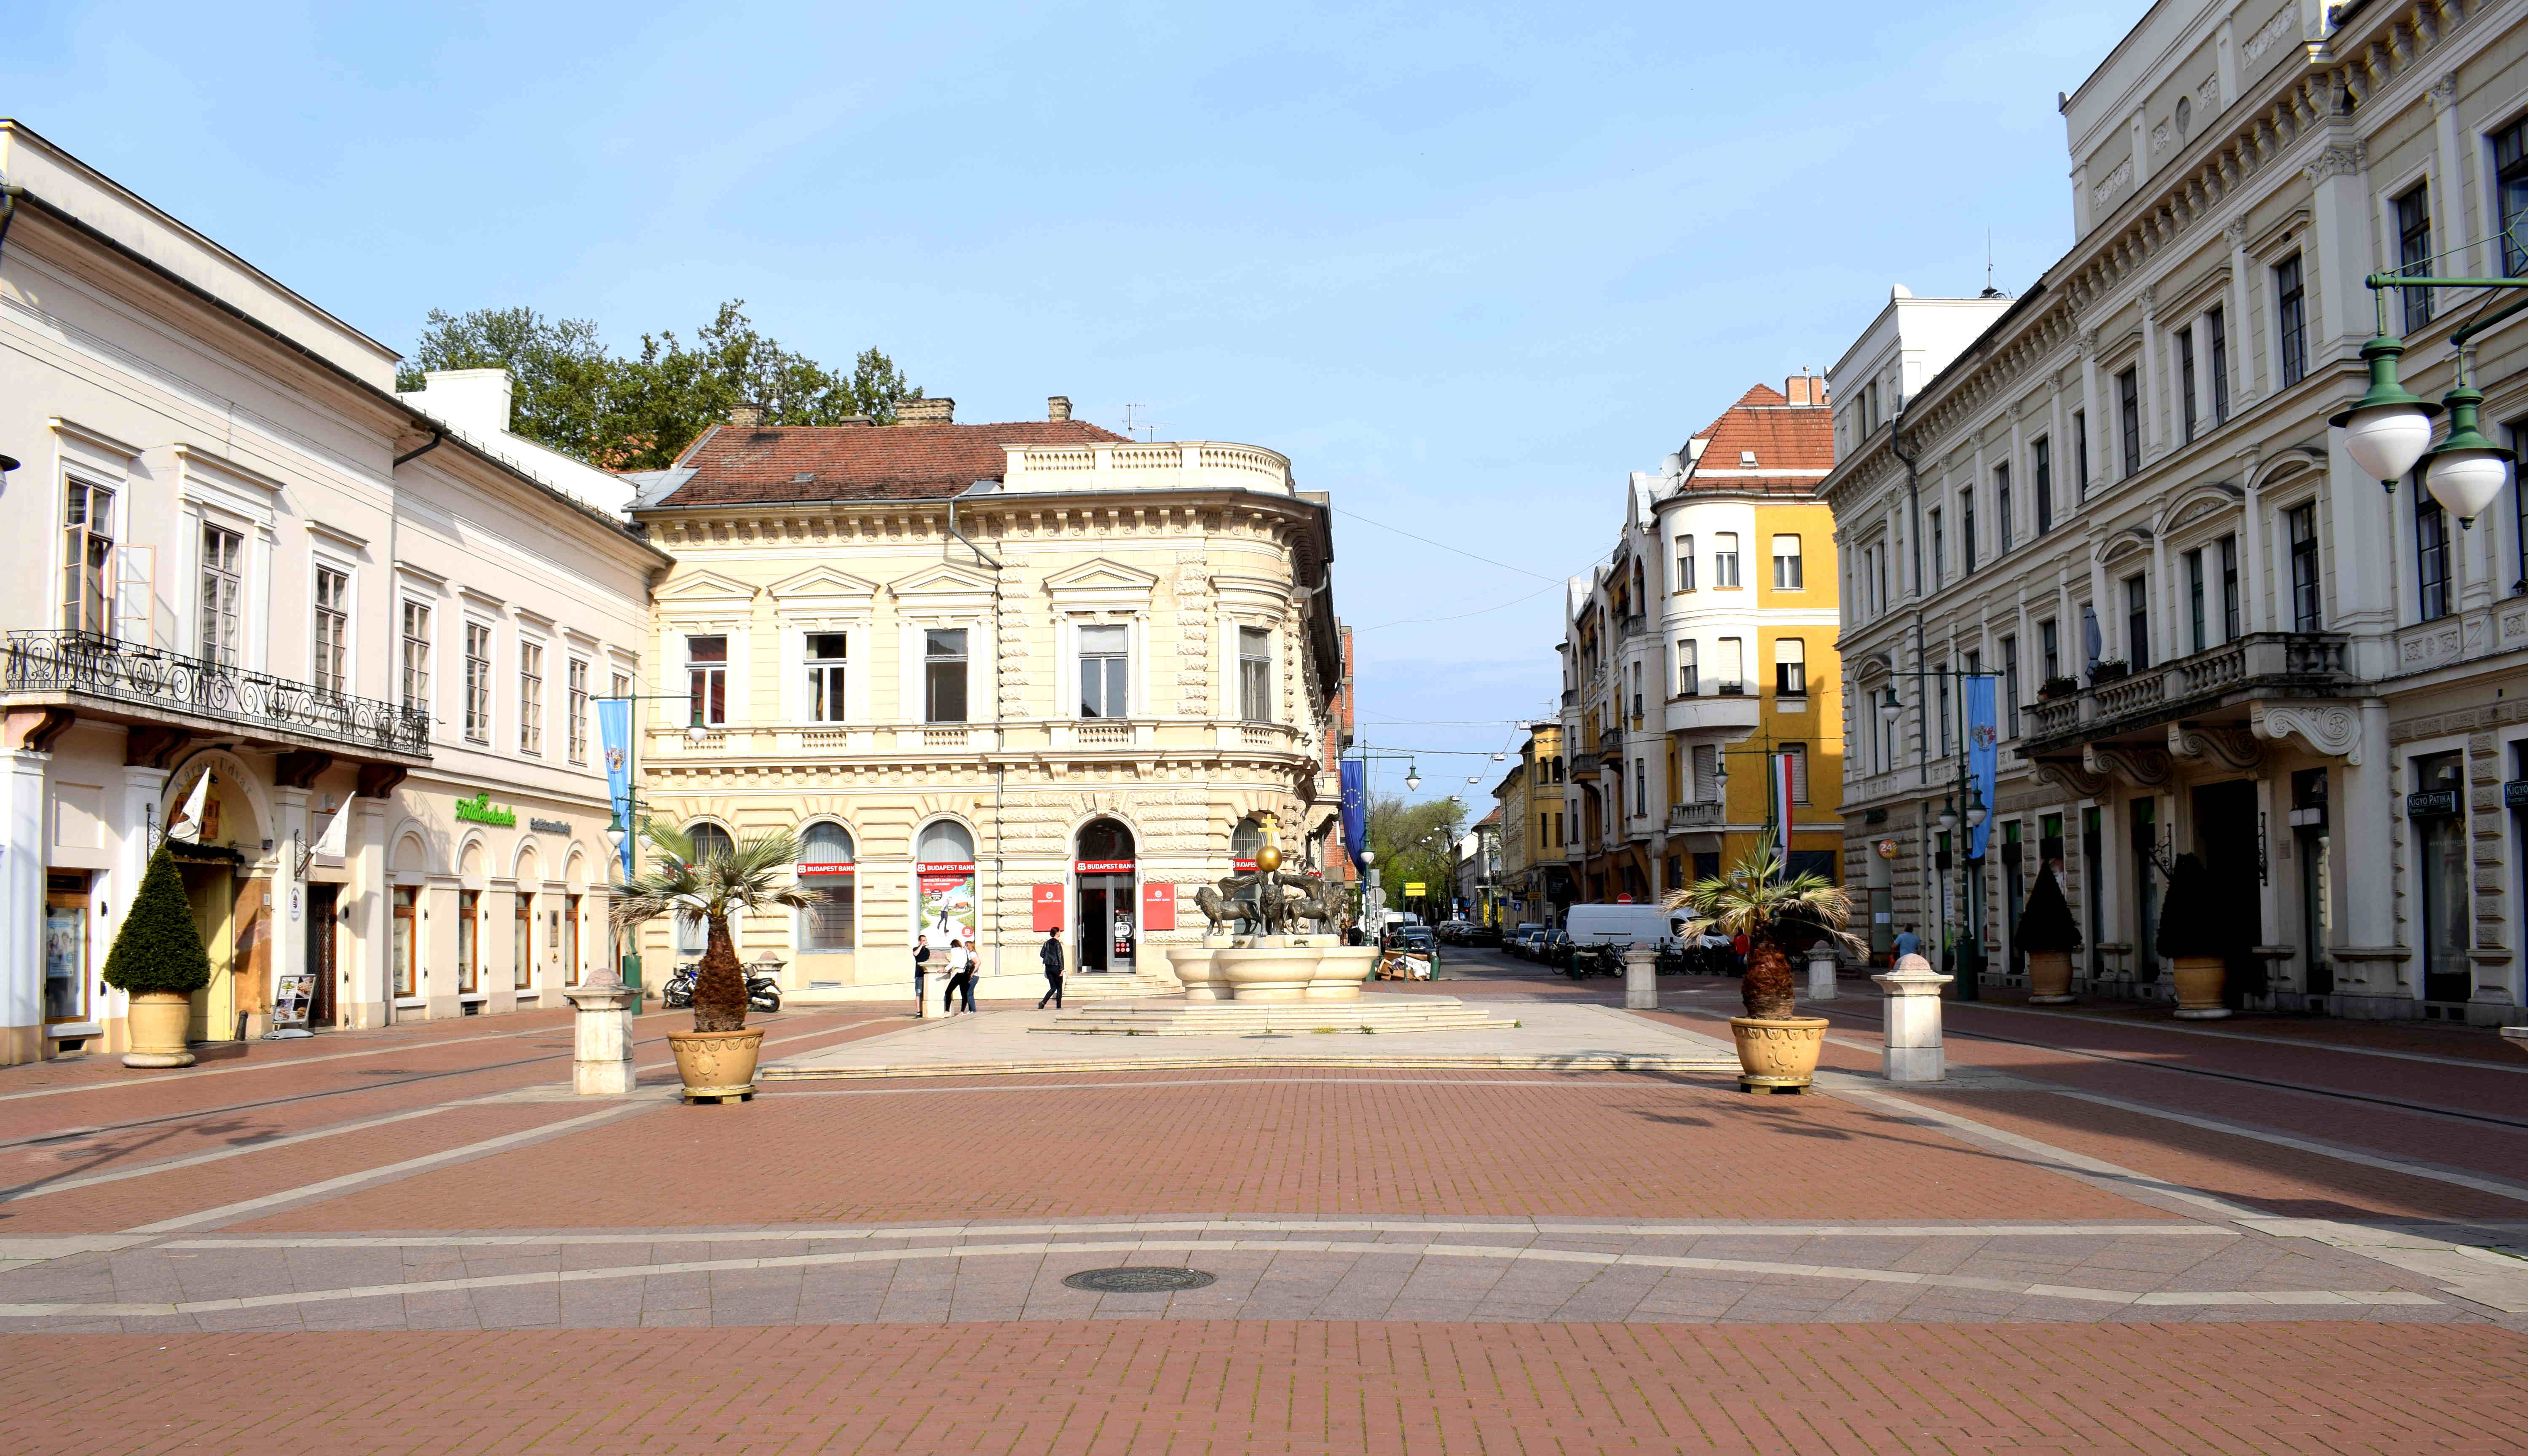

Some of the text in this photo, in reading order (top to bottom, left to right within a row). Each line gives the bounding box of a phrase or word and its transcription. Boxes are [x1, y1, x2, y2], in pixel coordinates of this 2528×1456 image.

[219, 757, 252, 794] Udvar
[2429, 795, 2450, 804] PATIKA
[1880, 843, 1892, 851] 24
